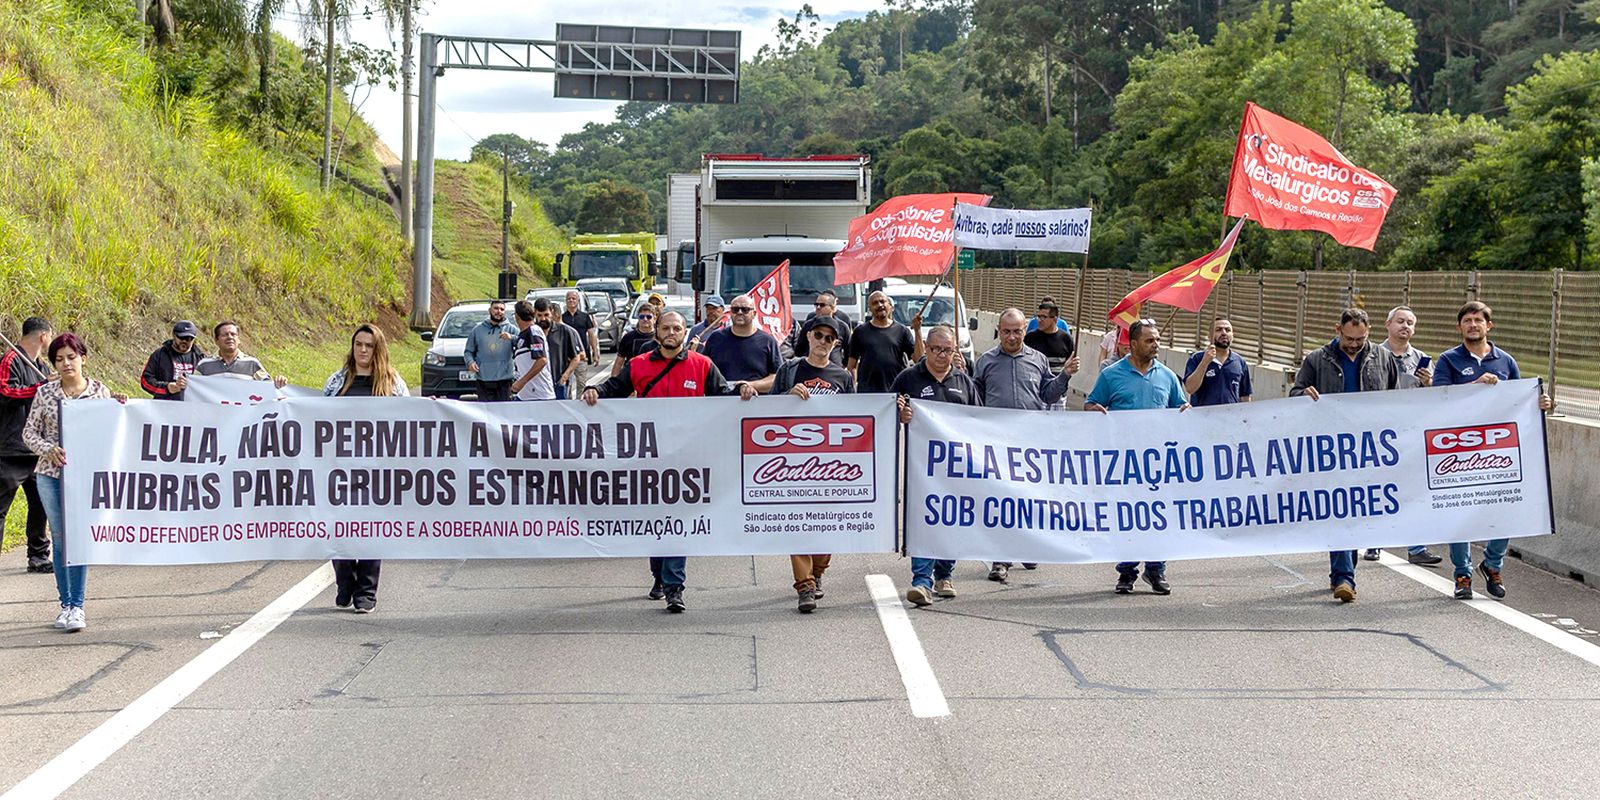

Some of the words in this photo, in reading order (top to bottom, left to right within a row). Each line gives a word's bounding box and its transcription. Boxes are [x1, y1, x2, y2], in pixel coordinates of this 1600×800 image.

[1264, 142, 1349, 183] Sindicato
[1243, 154, 1350, 206] Metalúrgicos
[1265, 195, 1283, 209] José
[1284, 200, 1298, 212] dos
[1300, 205, 1330, 220] Campos
[1338, 212, 1363, 224] Região
[955, 213, 989, 238] Avibras,
[991, 218, 1013, 236] cadê
[1015, 221, 1047, 236] nossos
[1048, 219, 1090, 237] salários?
[141, 423, 227, 465] LULA,
[237, 412, 301, 459] NÃO
[314, 420, 458, 458] PERMITA
[469, 422, 490, 458] A
[500, 422, 605, 459] VENDA
[616, 422, 659, 458] DA
[751, 422, 865, 448] CSP
[1432, 428, 1511, 450] CSP
[753, 455, 863, 484] Conlutas
[927, 440, 1002, 480] PELA
[1007, 441, 1205, 491] ESTATIZAÇÃO
[1213, 442, 1257, 481] DA
[1265, 429, 1400, 477] AVIBRAS
[1435, 453, 1513, 475] Conlutas
[91, 471, 221, 511] AVIBRAS
[232, 469, 316, 508] PARA
[328, 468, 457, 506] GRUPOS
[468, 467, 711, 506] ESTRANGEIROS!
[749, 489, 785, 498] CENTRAL
[787, 488, 823, 497] SINDICAL
[825, 488, 830, 496] E
[832, 487, 869, 496] POPULAR
[1433, 477, 1459, 485] CENTRAL
[925, 494, 975, 527] SOB
[983, 497, 1110, 532] CONTROLE
[1117, 501, 1168, 532] DOS
[1173, 483, 1400, 531] TRABALHADORES
[1432, 493, 1462, 501] Sindicato
[1475, 489, 1512, 498] Metalúrgicos
[1445, 500, 1459, 508] José
[1461, 499, 1472, 507] dos
[1473, 498, 1497, 506] Campos
[1503, 495, 1523, 504] Região
[744, 523, 760, 533] São
[761, 523, 782, 533] José
[784, 523, 800, 532] dos
[802, 522, 837, 533] Campos
[847, 521, 875, 532] Região
[745, 512, 786, 521] Sindicato
[788, 512, 804, 521] dos
[806, 510, 860, 521] Metalúrgicos
[862, 510, 873, 519] de
[91, 525, 135, 543] VAMOS
[139, 525, 219, 543] DEFENDER
[223, 523, 243, 541] OS
[247, 521, 331, 540] EMPREGOS,
[335, 520, 403, 538] DIREITOS
[406, 521, 415, 537] E
[418, 521, 429, 537] A
[432, 520, 519, 538] SOBERANIA
[523, 520, 543, 537] DO
[547, 516, 583, 537] PAÍS.
[587, 516, 687, 541] ESTATIZAÇÃO,
[691, 515, 711, 536] JÁ!
